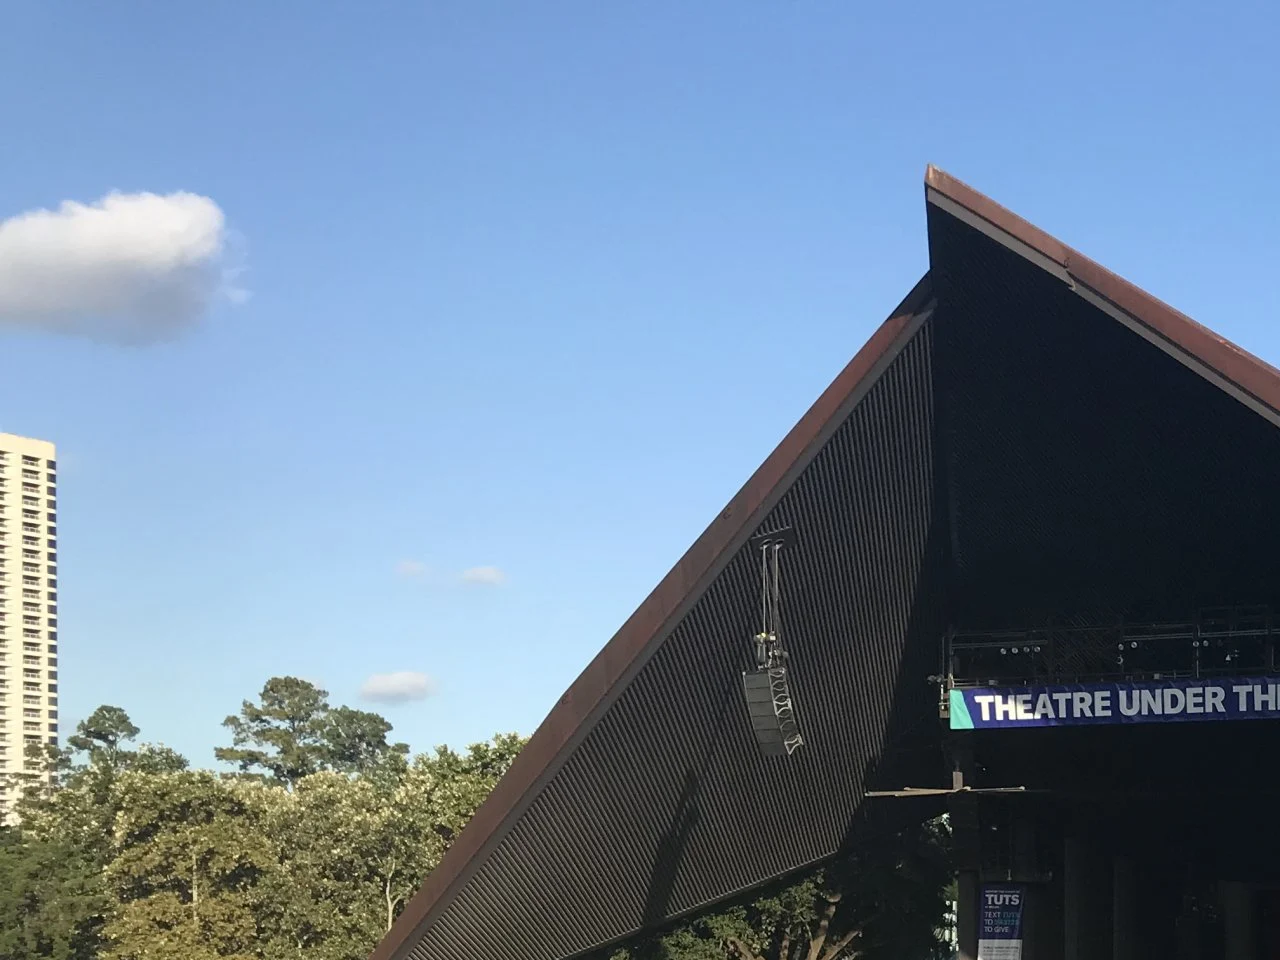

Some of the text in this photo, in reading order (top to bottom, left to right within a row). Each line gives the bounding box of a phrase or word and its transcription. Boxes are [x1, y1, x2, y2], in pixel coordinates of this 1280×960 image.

[974, 690, 1112, 721] THEATRE
[1118, 686, 1226, 717] UNDER
[985, 894, 1020, 905] TUTS
